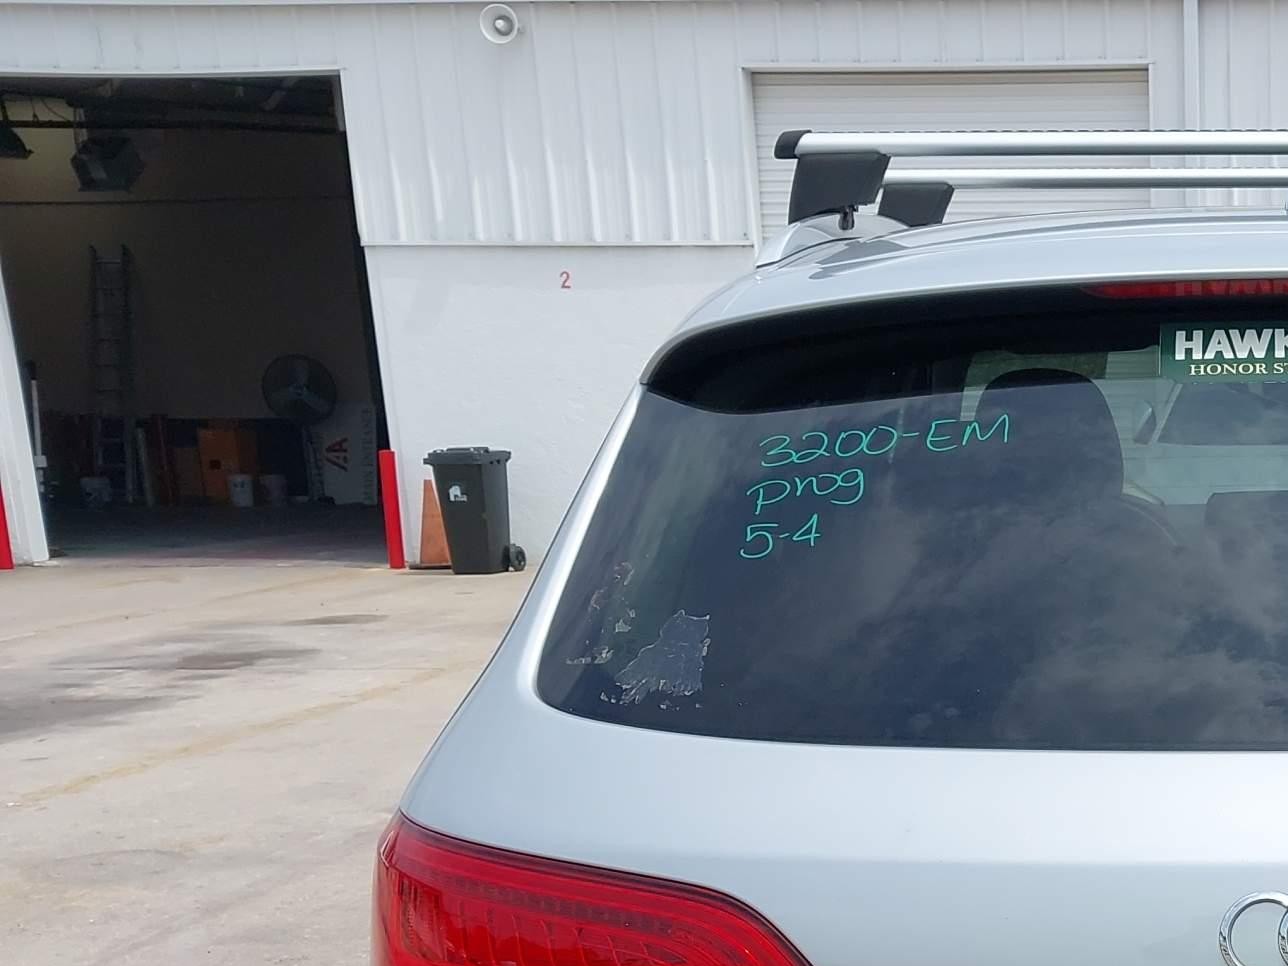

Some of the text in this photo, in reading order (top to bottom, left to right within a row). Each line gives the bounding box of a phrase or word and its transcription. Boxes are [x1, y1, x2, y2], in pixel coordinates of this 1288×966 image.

[559, 270, 571, 289] 2
[1188, 362, 1267, 376] HONOR
[759, 413, 1009, 467] 3200-EM
[739, 513, 821, 559] 5-4
